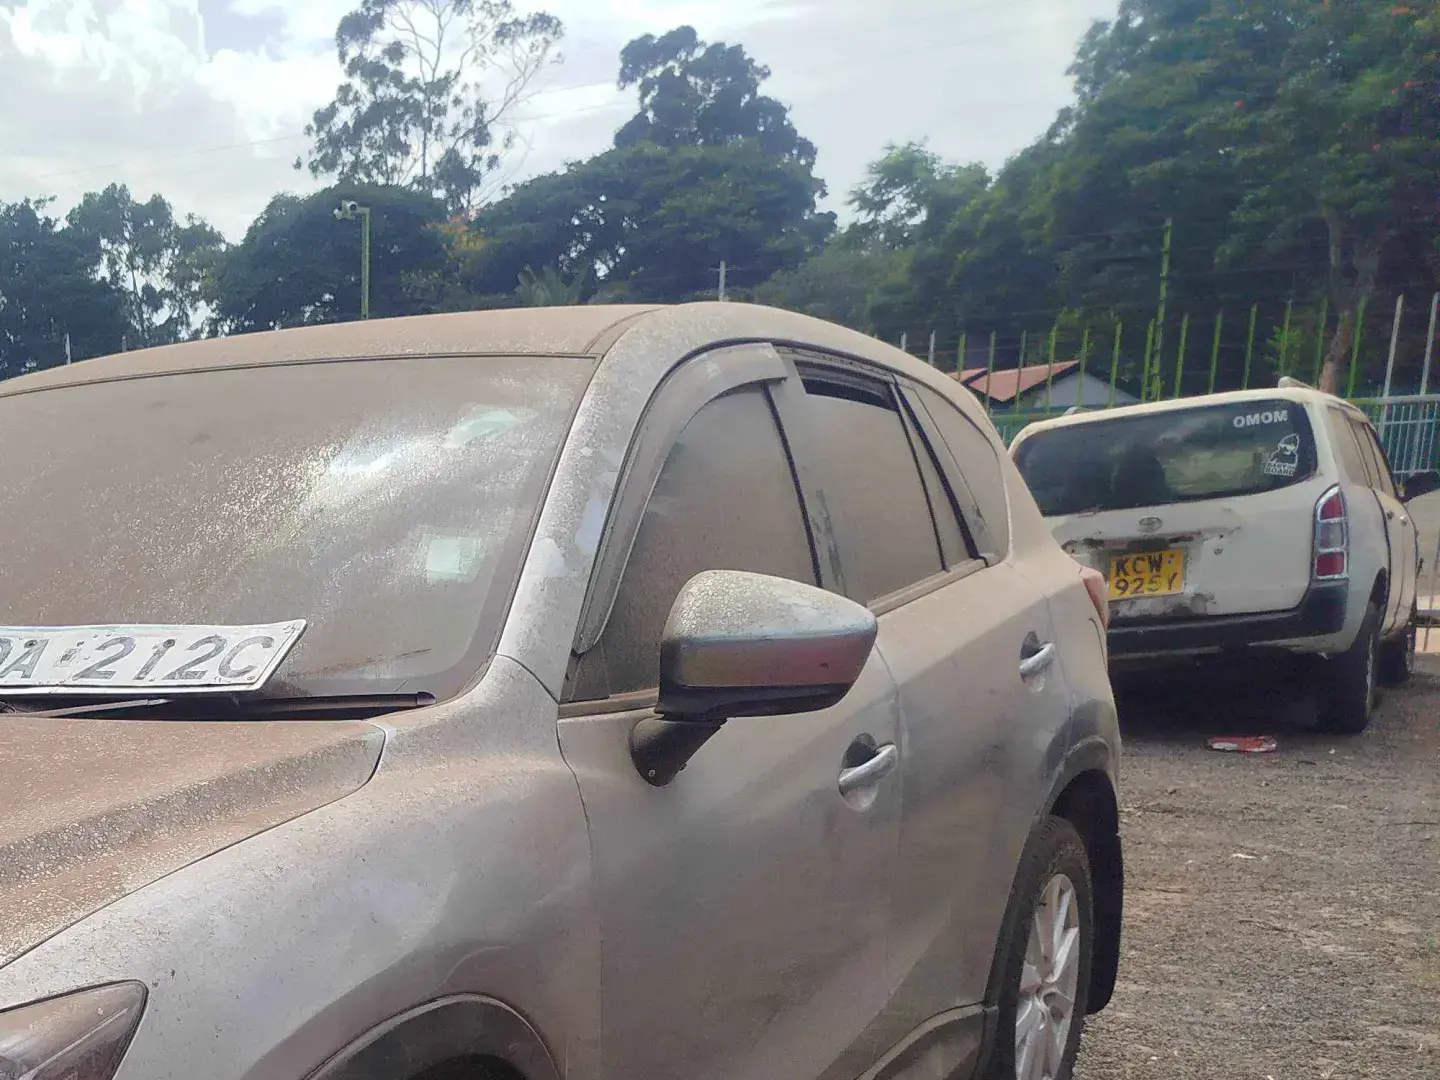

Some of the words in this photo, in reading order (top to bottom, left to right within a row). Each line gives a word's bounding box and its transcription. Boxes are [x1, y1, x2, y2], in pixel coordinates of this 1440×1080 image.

[1233, 409, 1289, 428] OMOM
[1116, 554, 1163, 577] KCW
[1115, 572, 1178, 596] 925Y
[74, 635, 275, 681] 212C
